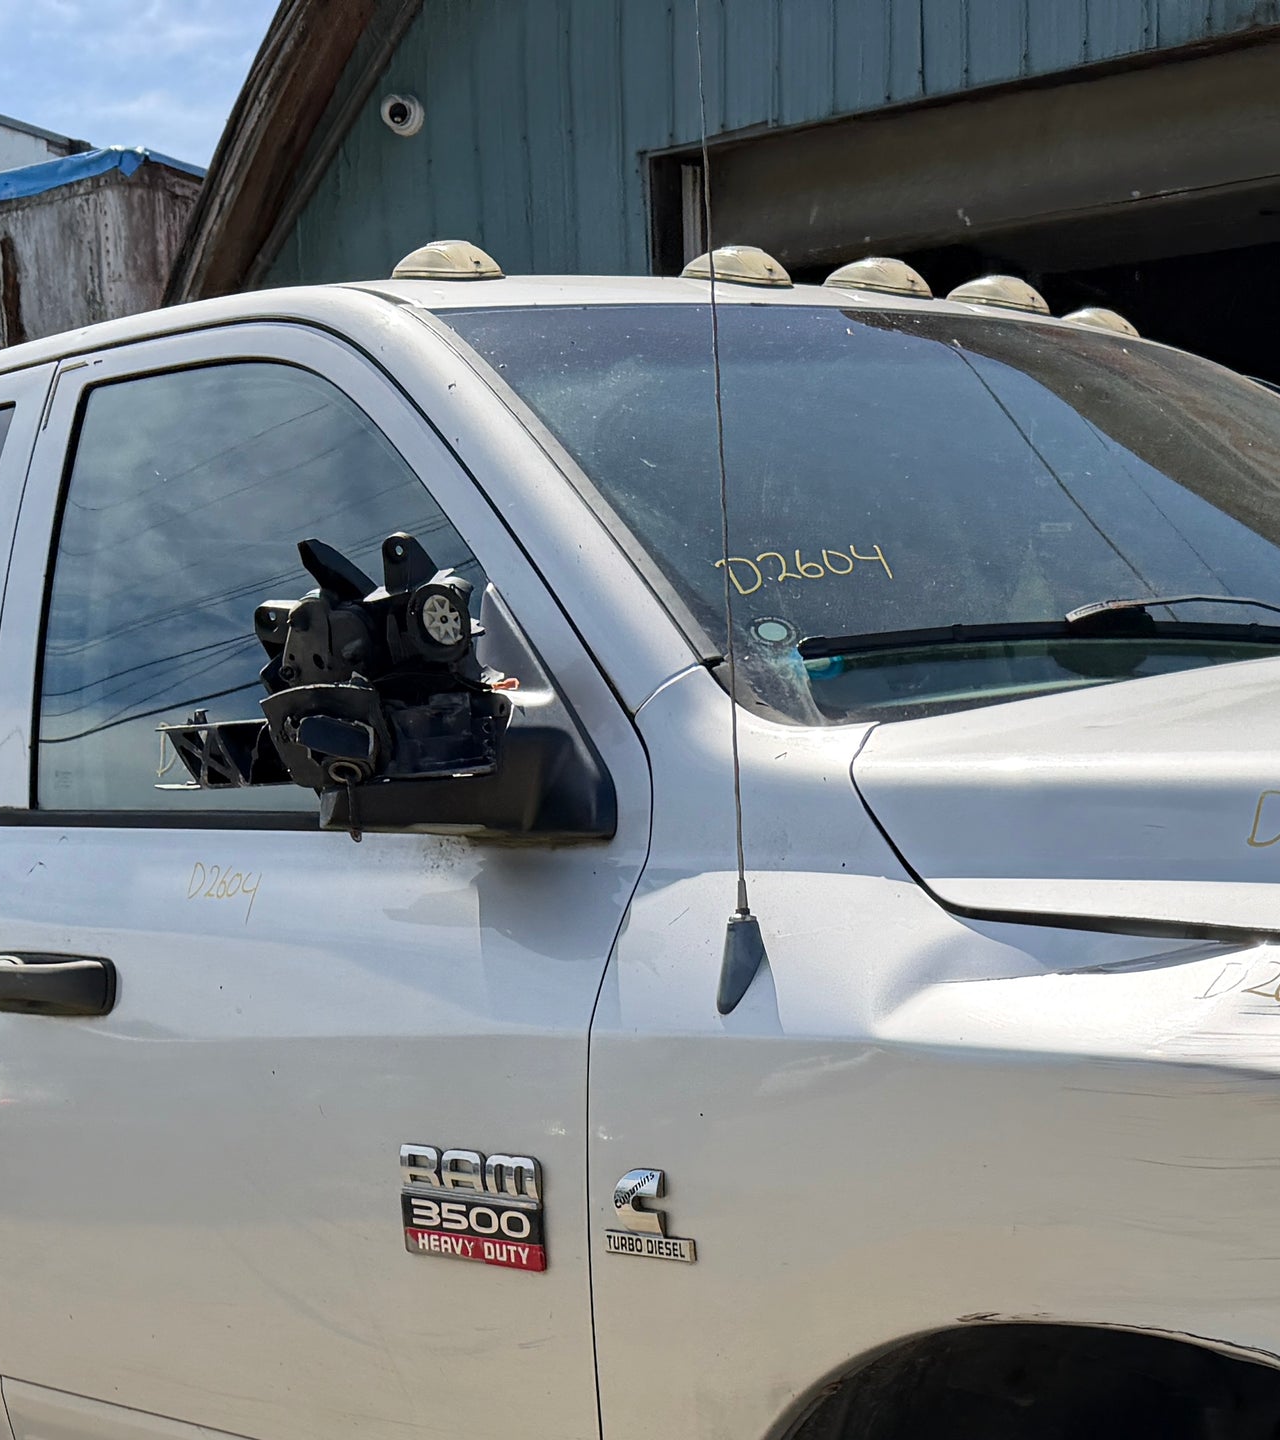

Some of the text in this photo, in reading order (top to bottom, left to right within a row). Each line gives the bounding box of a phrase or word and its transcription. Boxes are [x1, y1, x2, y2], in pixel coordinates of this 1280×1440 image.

[714, 545, 893, 594] D2604
[188, 862, 262, 925] D2604
[399, 1143, 543, 1199] RAM
[614, 1171, 655, 1209] Cummins
[412, 1199, 531, 1239] 3500
[417, 1232, 530, 1265] HEAVY DUTY
[606, 1234, 686, 1259] TURBO DIESEL
